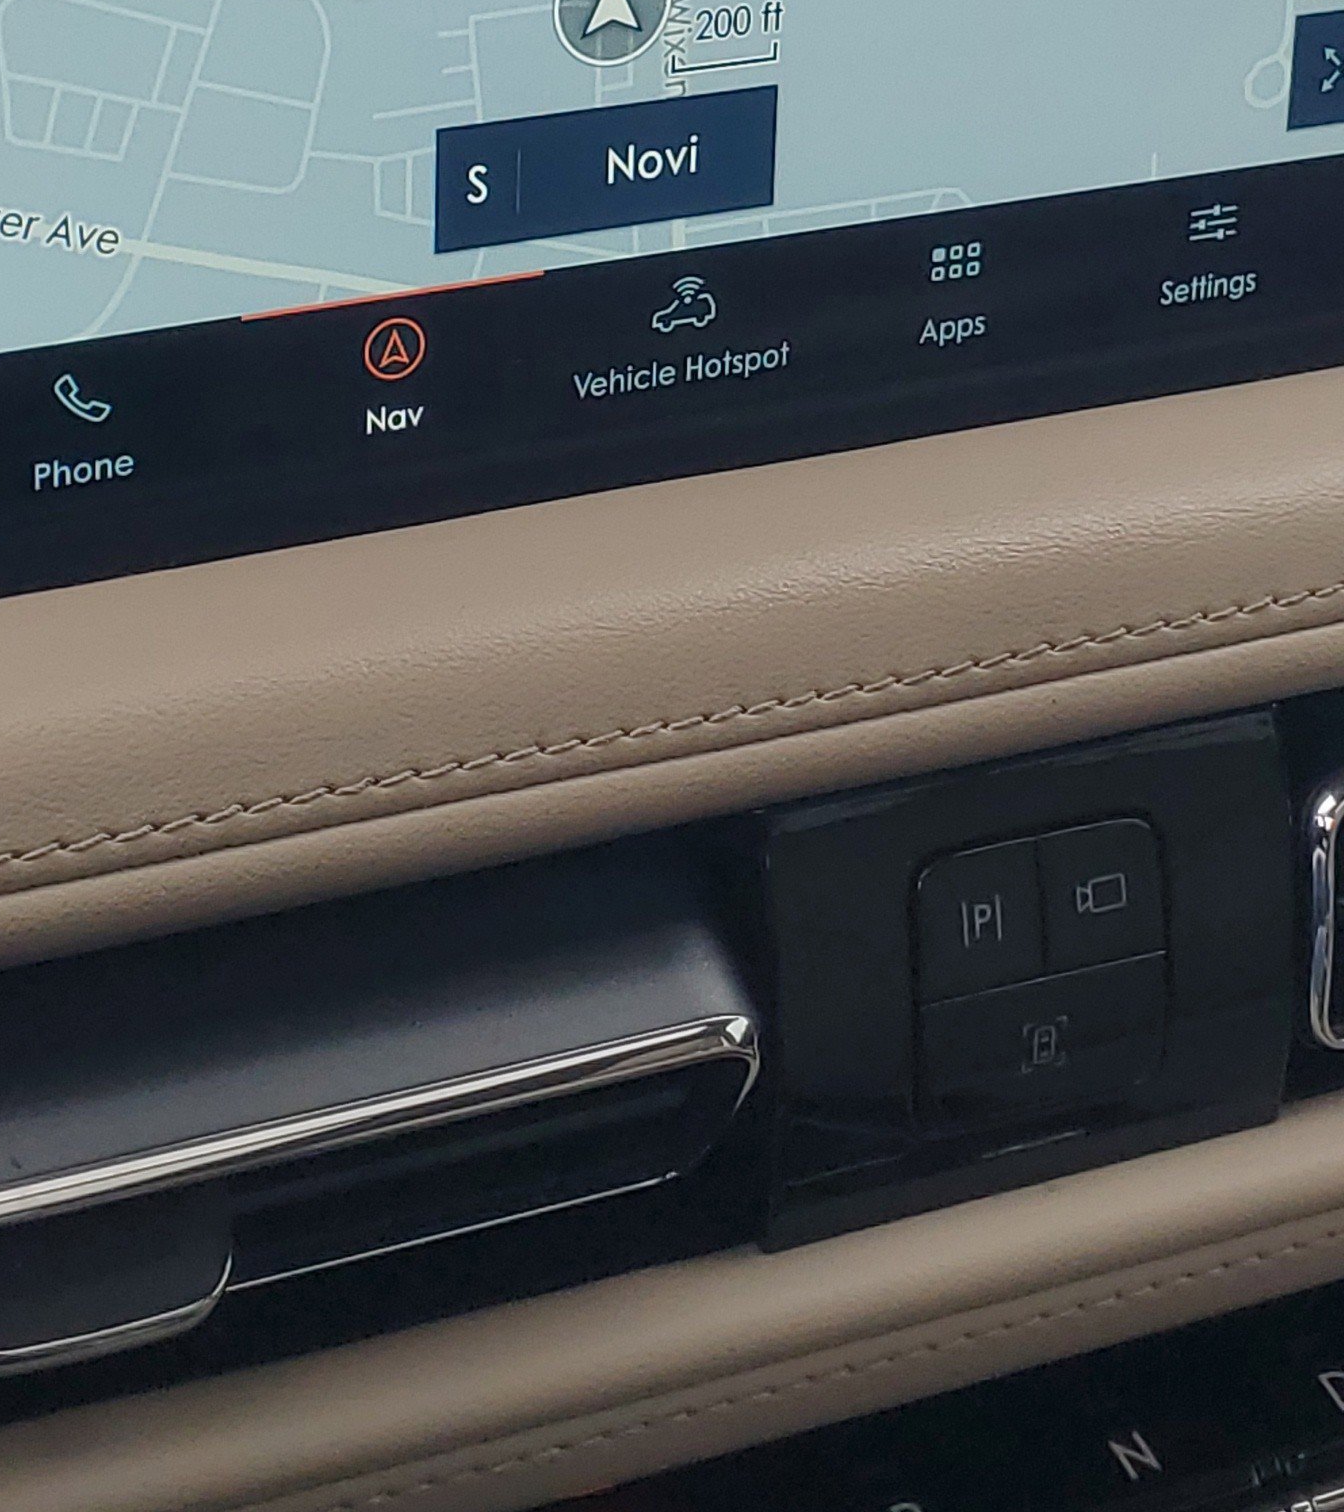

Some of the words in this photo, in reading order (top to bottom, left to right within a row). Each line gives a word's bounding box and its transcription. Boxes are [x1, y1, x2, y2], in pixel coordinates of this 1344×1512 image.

[695, 5, 752, 41] 200
[761, 1, 784, 32] ft
[466, 163, 490, 205] S
[605, 135, 701, 185] Novi
[45, 215, 121, 256] Ave
[1159, 272, 1257, 306] Settings
[919, 315, 988, 347] Apps
[573, 365, 676, 400] Vehicle
[685, 341, 791, 382] Hotspot
[365, 405, 425, 434] Nav
[33, 454, 136, 491] Phone
[1107, 1430, 1163, 1481] N
